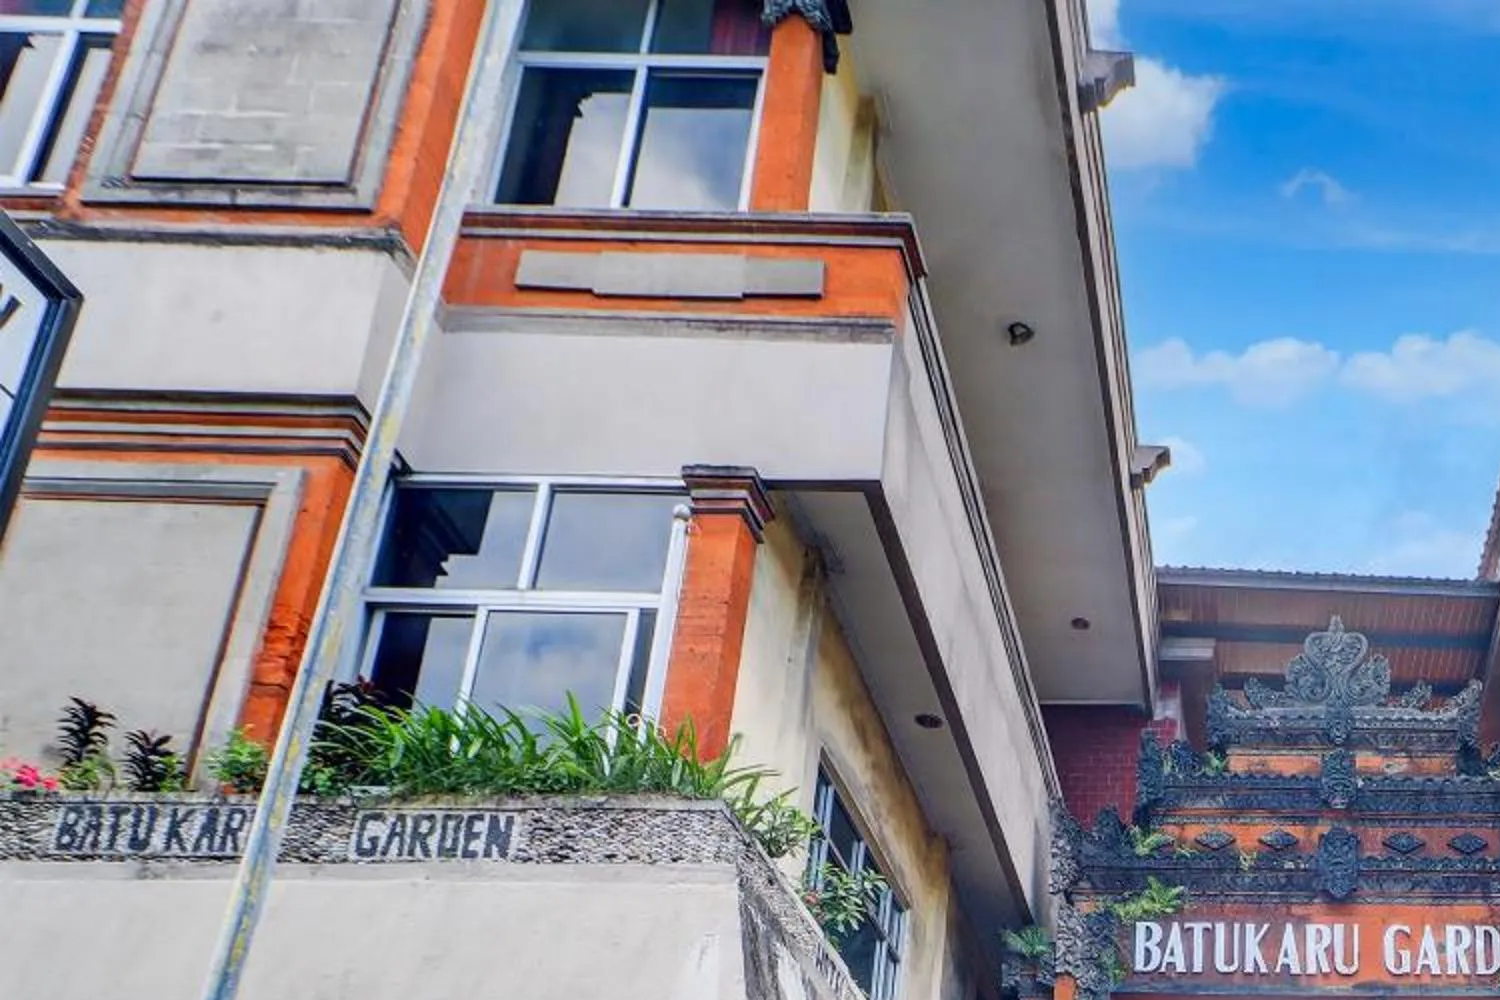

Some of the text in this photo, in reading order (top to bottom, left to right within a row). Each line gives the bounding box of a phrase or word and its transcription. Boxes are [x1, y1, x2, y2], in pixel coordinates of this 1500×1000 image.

[56, 805, 516, 858] BATUKAR GARDEN
[1133, 920, 1360, 975] BATUKARU
